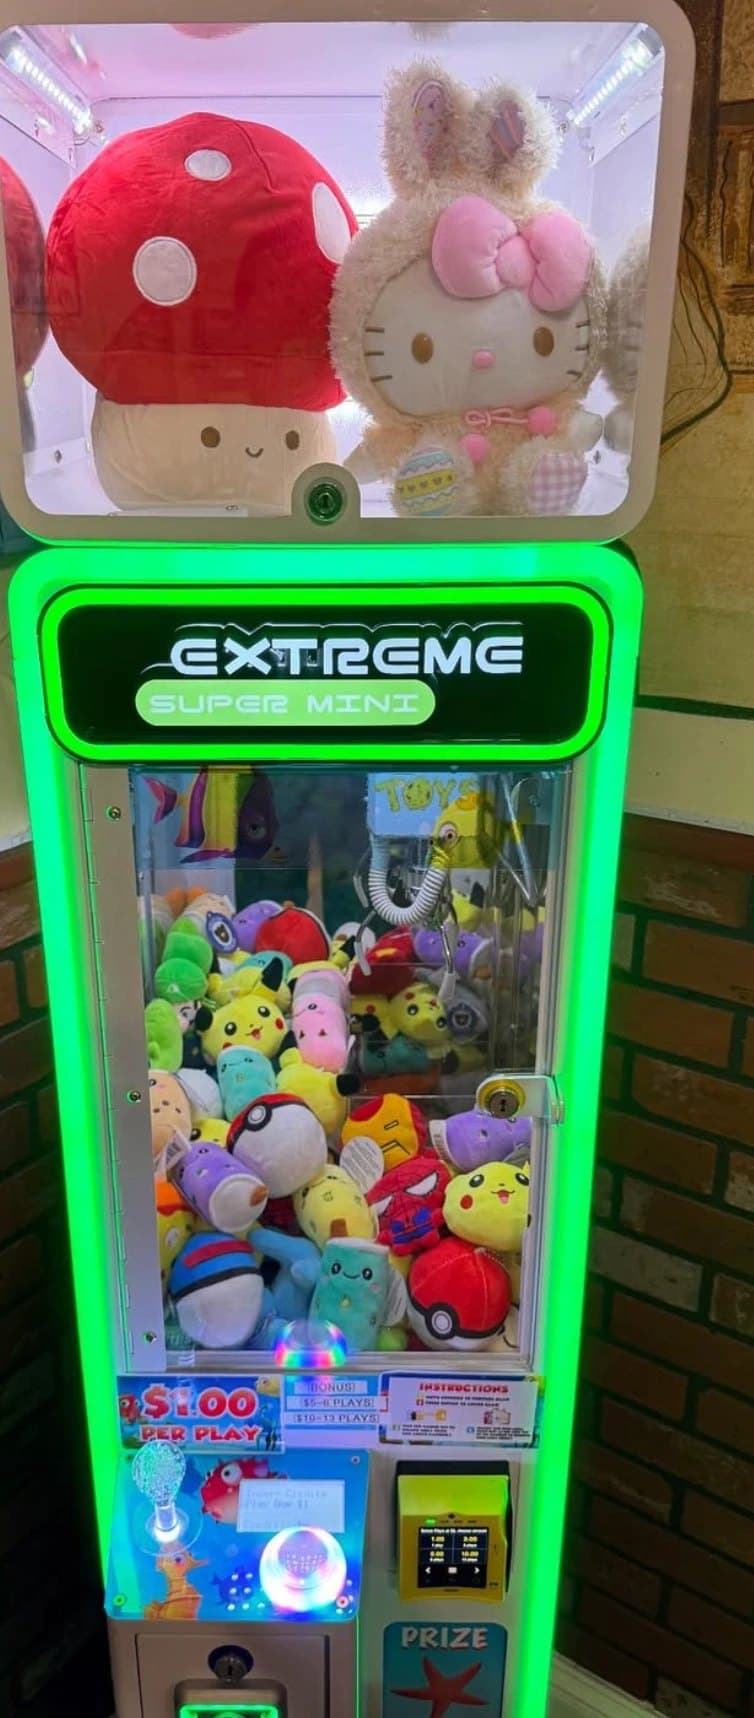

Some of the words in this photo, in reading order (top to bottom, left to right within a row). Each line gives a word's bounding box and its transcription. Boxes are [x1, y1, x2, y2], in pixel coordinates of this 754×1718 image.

[171, 636, 524, 675] EXTREME
[149, 694, 289, 714] SUPER
[306, 694, 420, 714] MINI
[419, 1383, 509, 1394] INSTRUCTIONS
[141, 1383, 258, 1419] $1.00
[332, 1399, 371, 1409] PLAYS
[339, 1414, 377, 1423] PLAYS
[140, 1425, 186, 1441] PER
[193, 1425, 263, 1442] PLAY
[401, 1626, 488, 1649] PRIZE
